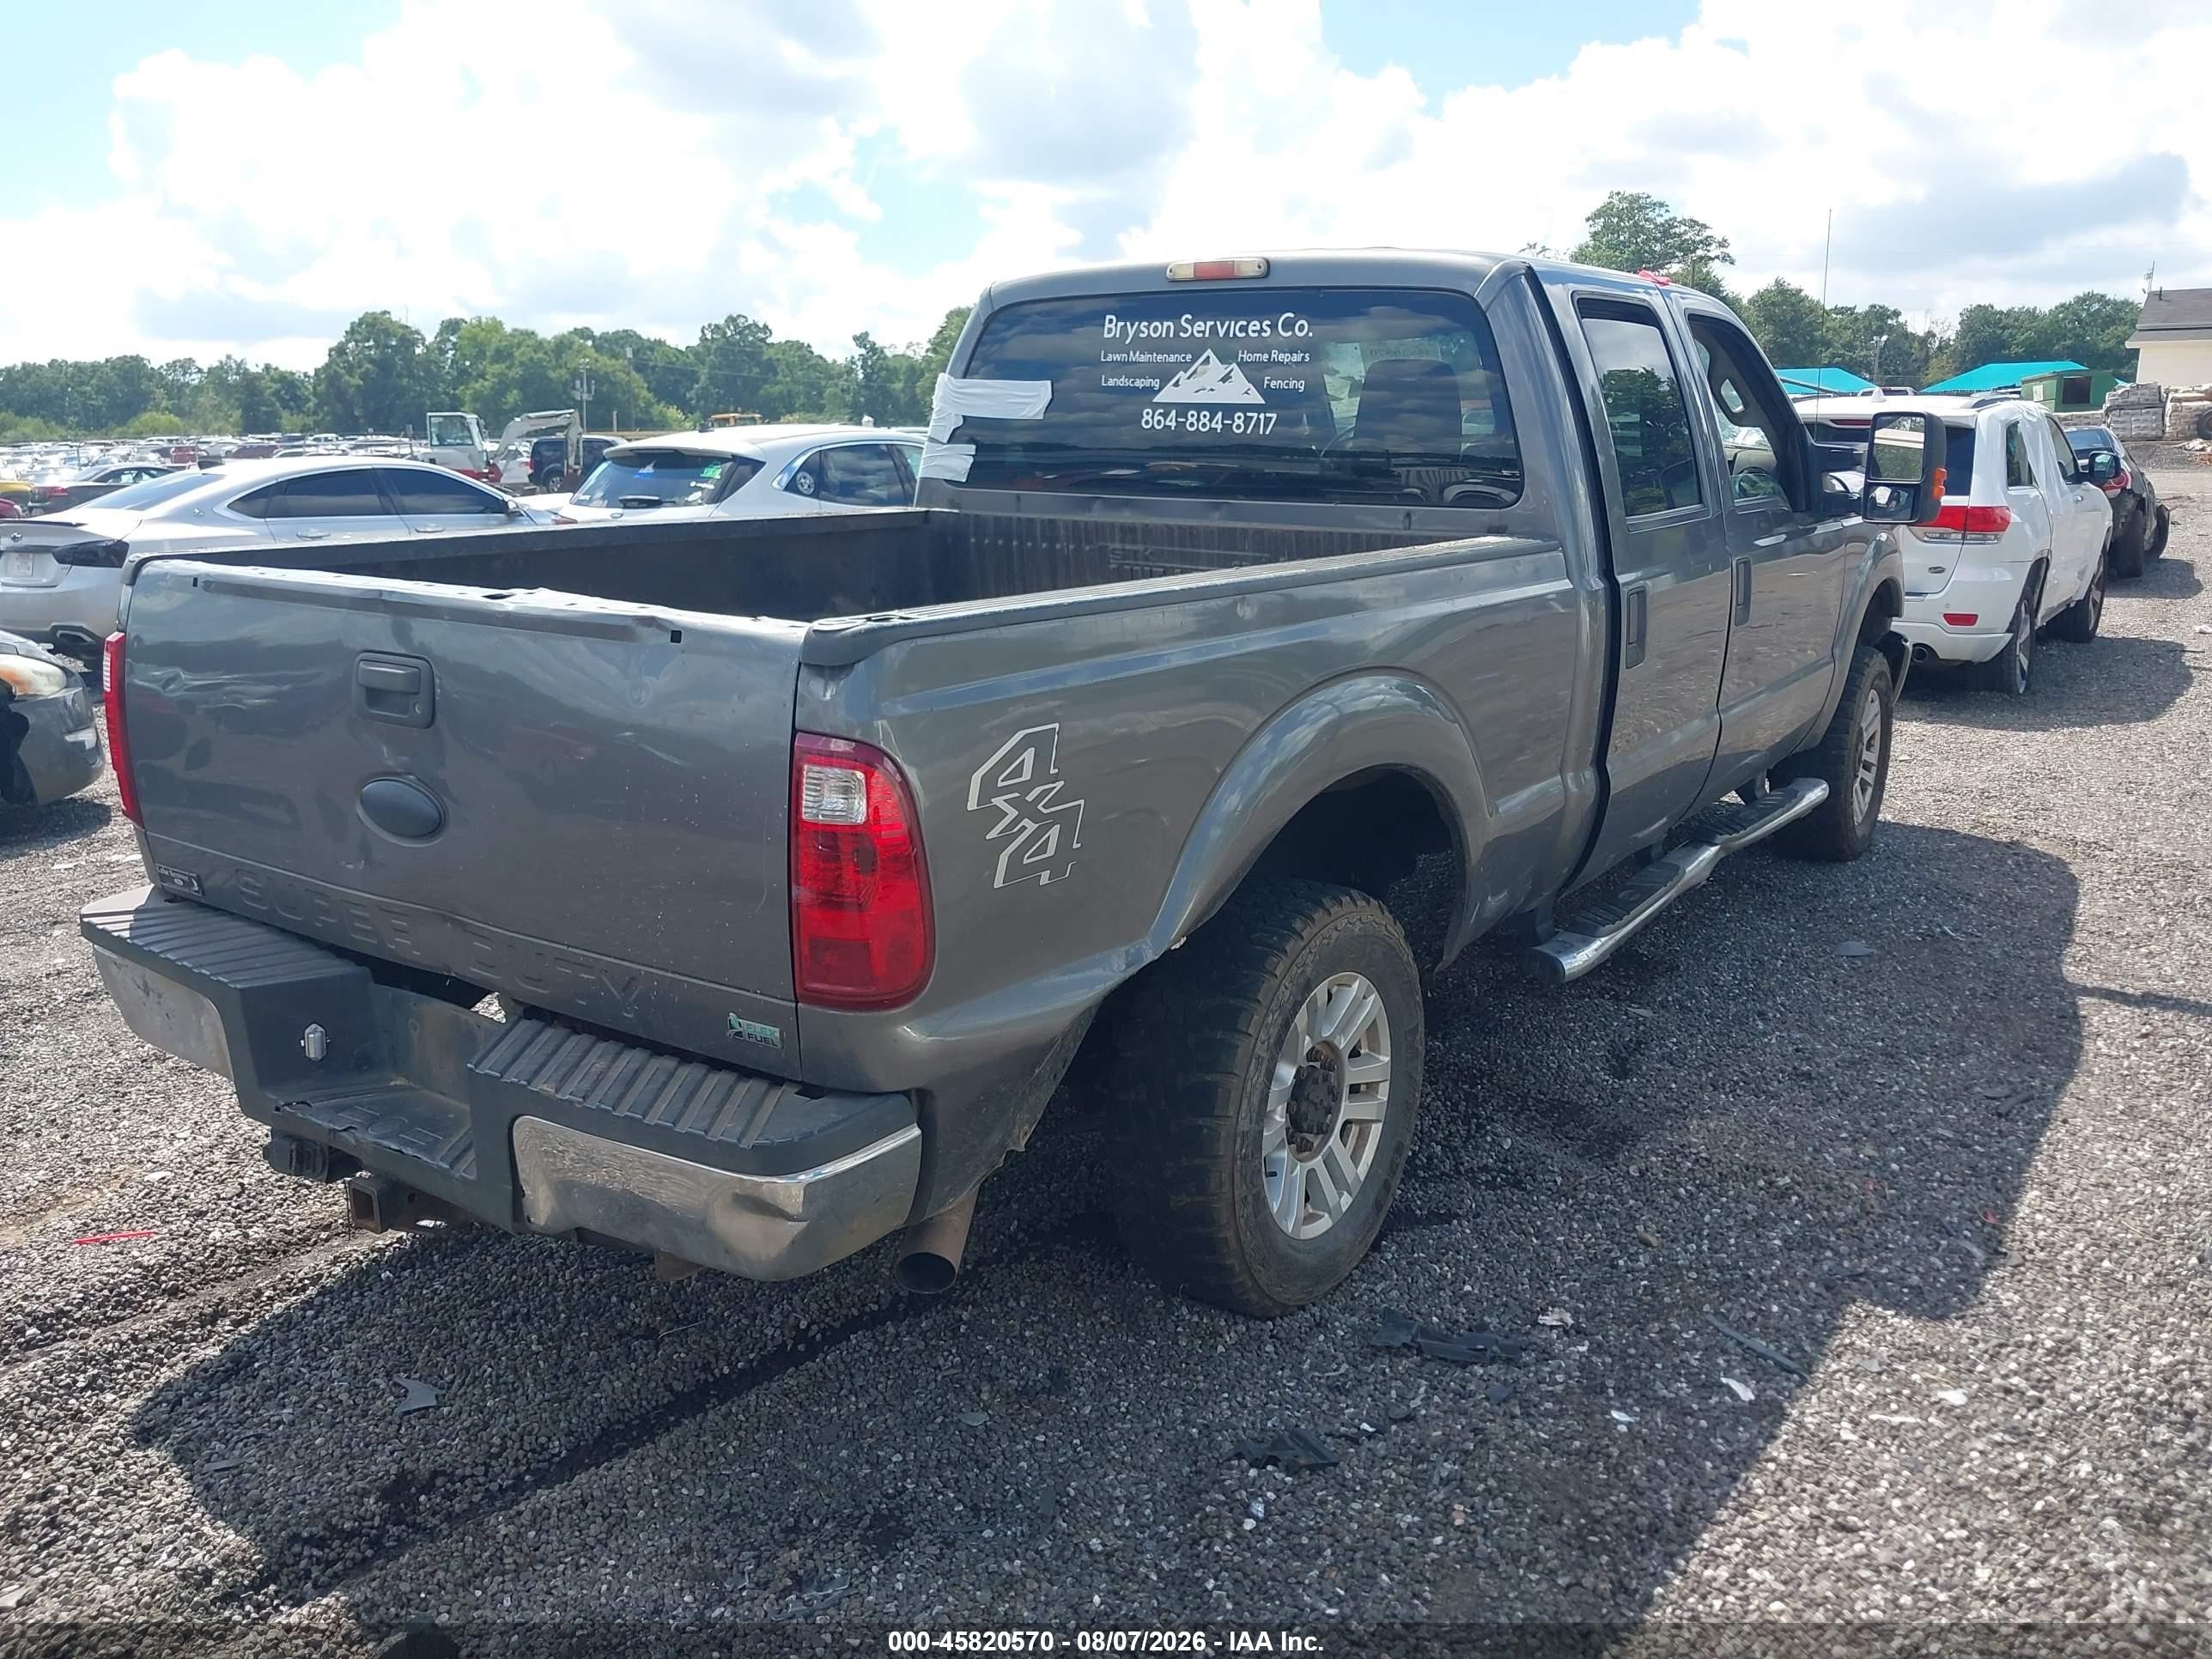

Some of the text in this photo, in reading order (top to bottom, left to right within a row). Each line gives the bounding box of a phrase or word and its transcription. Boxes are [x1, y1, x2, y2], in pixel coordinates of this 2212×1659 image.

[1103, 312, 1313, 344] Bryson Services Co.
[1100, 349, 1193, 362] Lawn Maintenance
[1237, 349, 1310, 365] Home Repairs
[1102, 374, 1160, 391] Landscaping
[1263, 376, 1305, 392] Fencing
[1141, 408, 1278, 434] 864-884-8717
[746, 1023, 777, 1039] FLEX
[747, 1032, 780, 1048] FUEL
